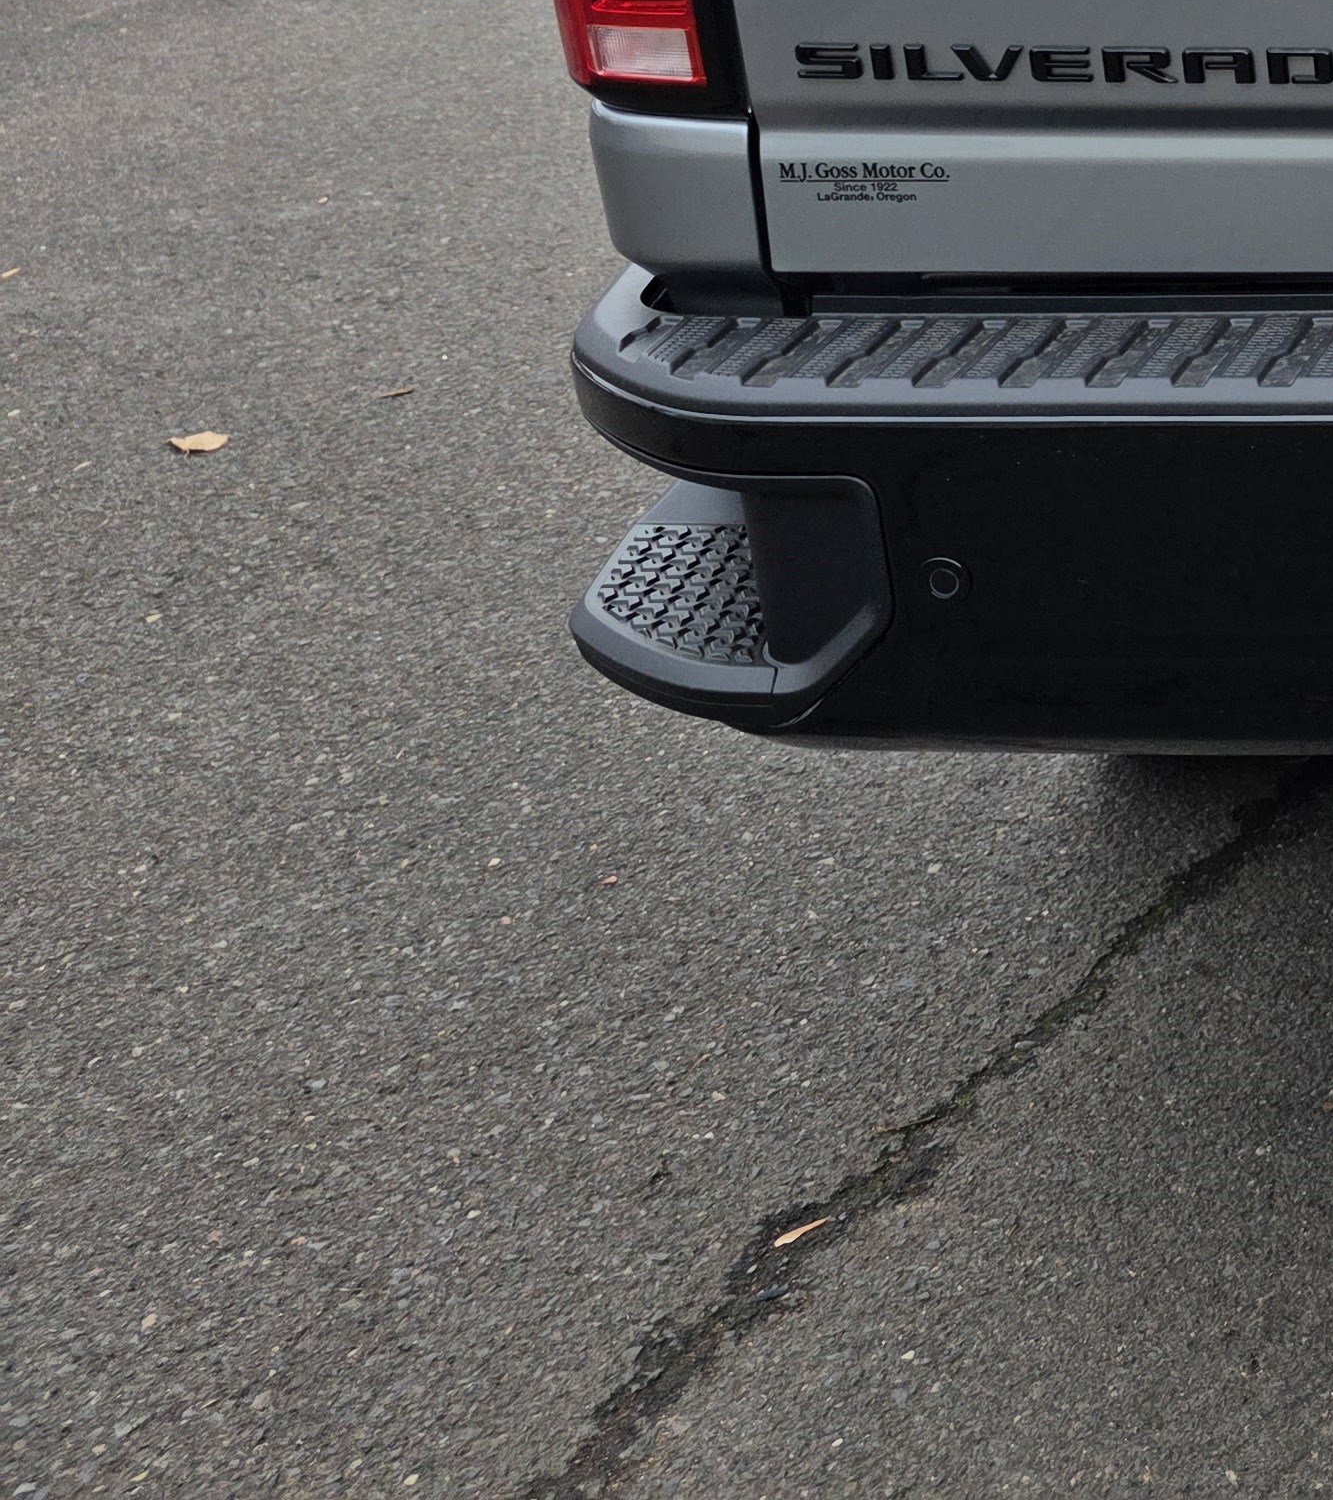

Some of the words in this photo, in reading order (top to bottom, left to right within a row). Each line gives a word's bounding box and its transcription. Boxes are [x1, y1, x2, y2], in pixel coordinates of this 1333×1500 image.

[779, 162, 812, 182] M.J.
[815, 162, 857, 178] Goss
[862, 162, 916, 178] Motor
[920, 162, 950, 178] Co.
[834, 182, 867, 192] Since
[871, 182, 898, 192] 1922
[817, 192, 874, 202] LaGrande,
[876, 192, 917, 203] Oregon
